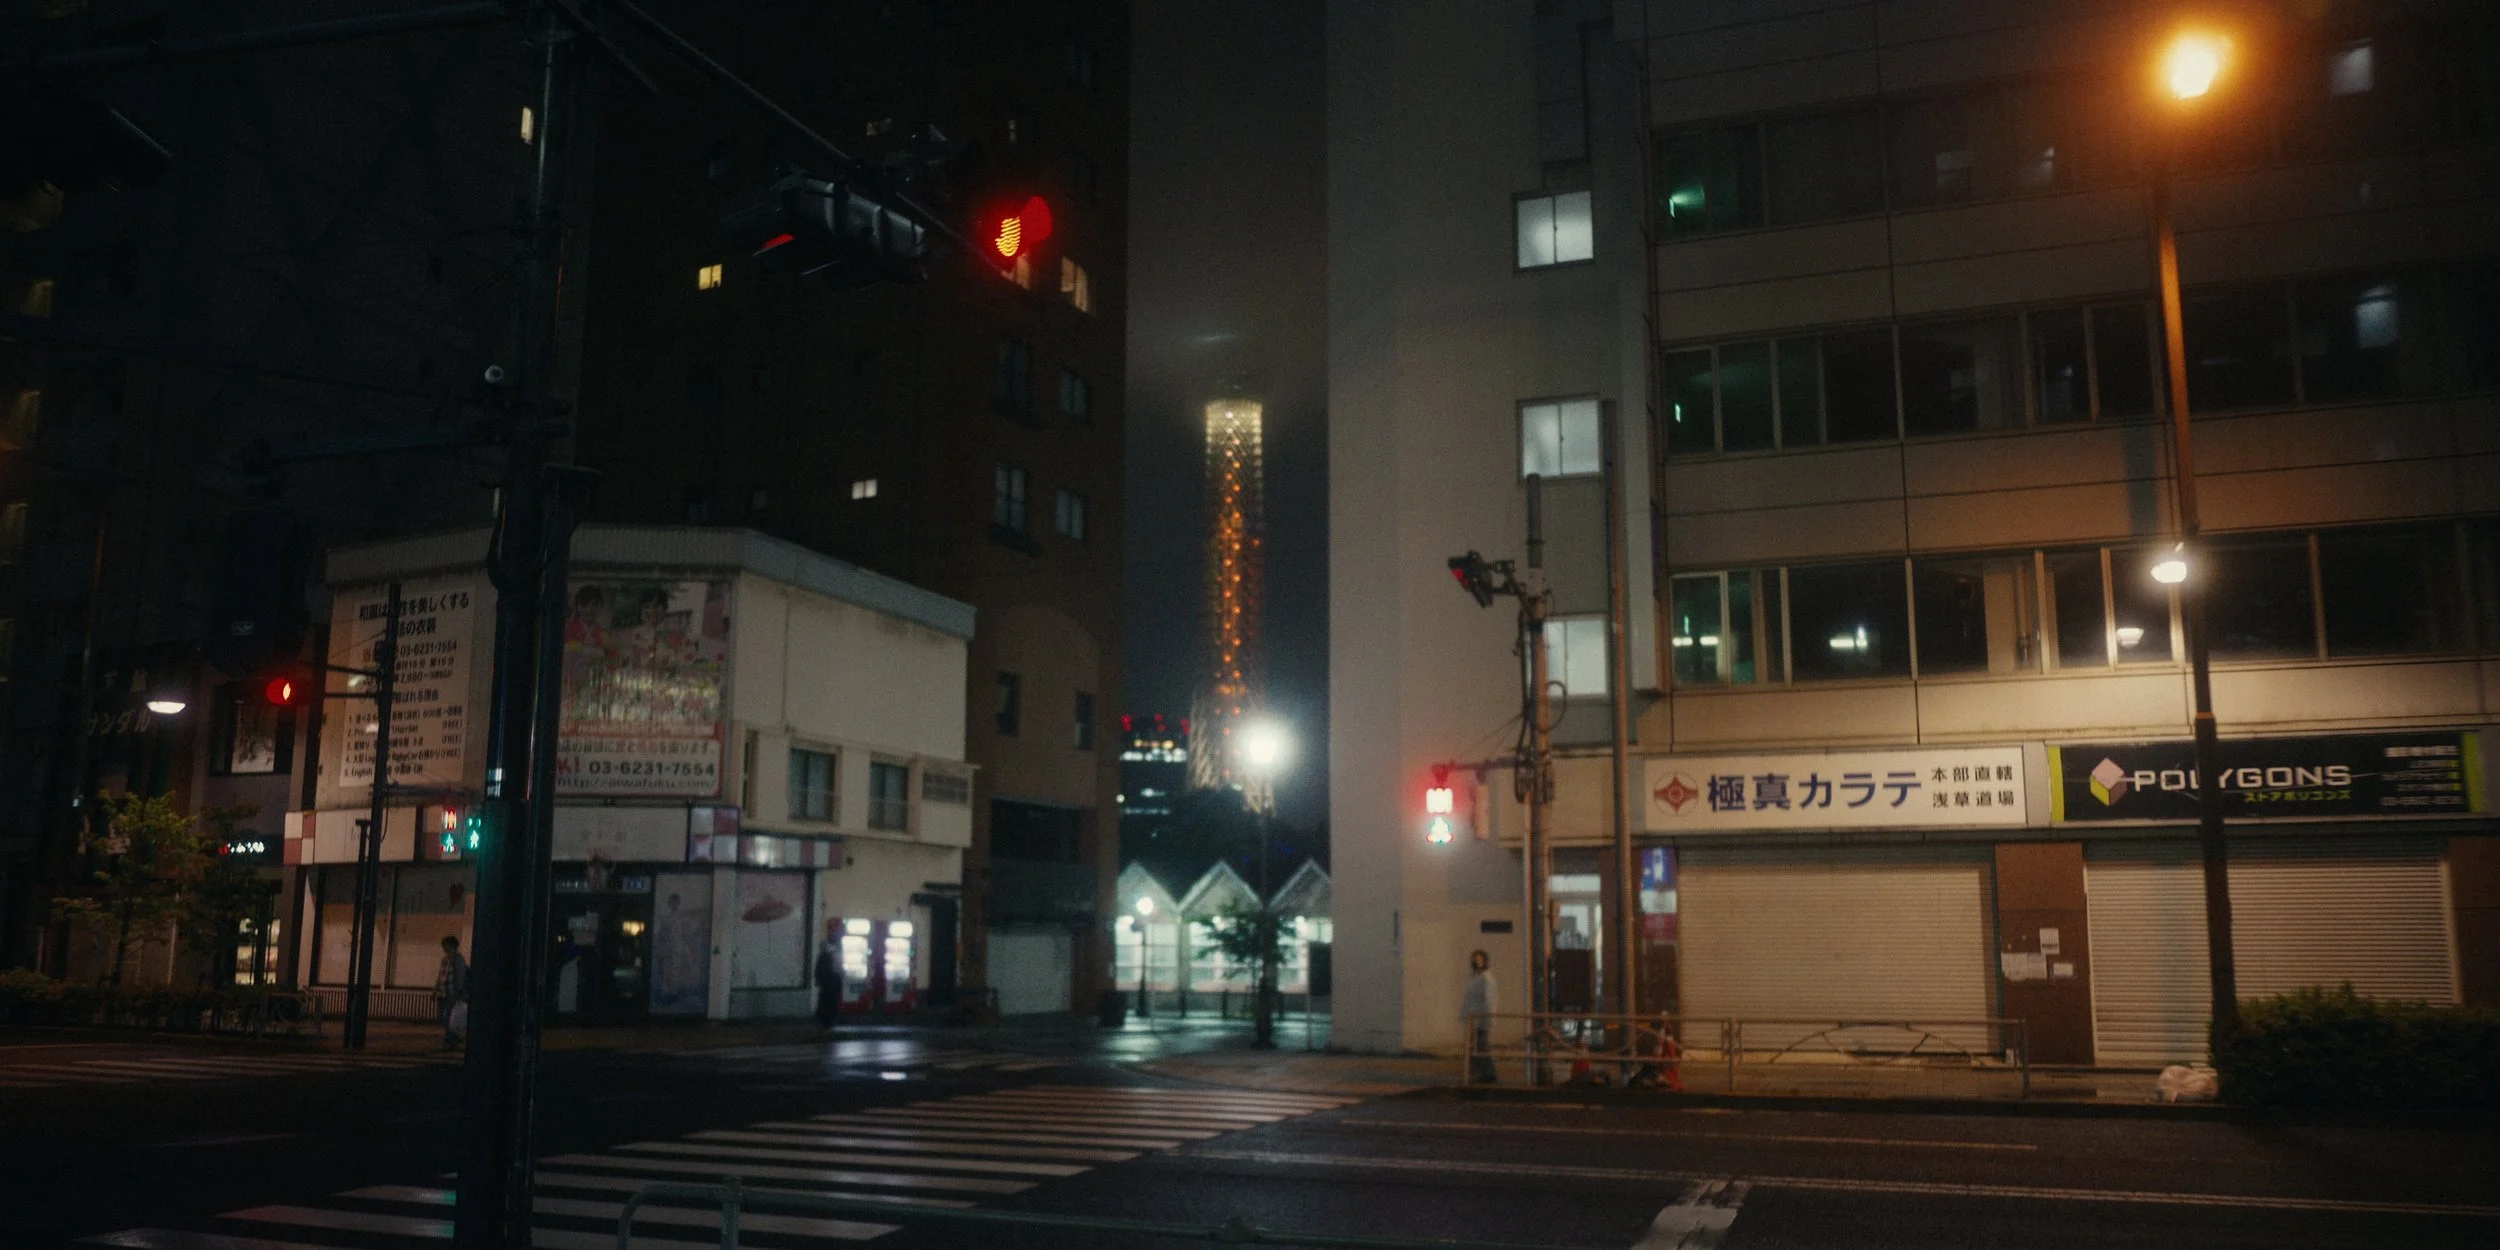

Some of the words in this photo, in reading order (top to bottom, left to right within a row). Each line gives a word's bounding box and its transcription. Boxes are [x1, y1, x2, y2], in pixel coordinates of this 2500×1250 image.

[589, 760, 715, 775] 03-6231-7554
[1931, 765, 2013, 783] 本部直轄
[1708, 772, 1922, 813] 極真カラテ
[1932, 789, 2015, 808] 浅草道場
